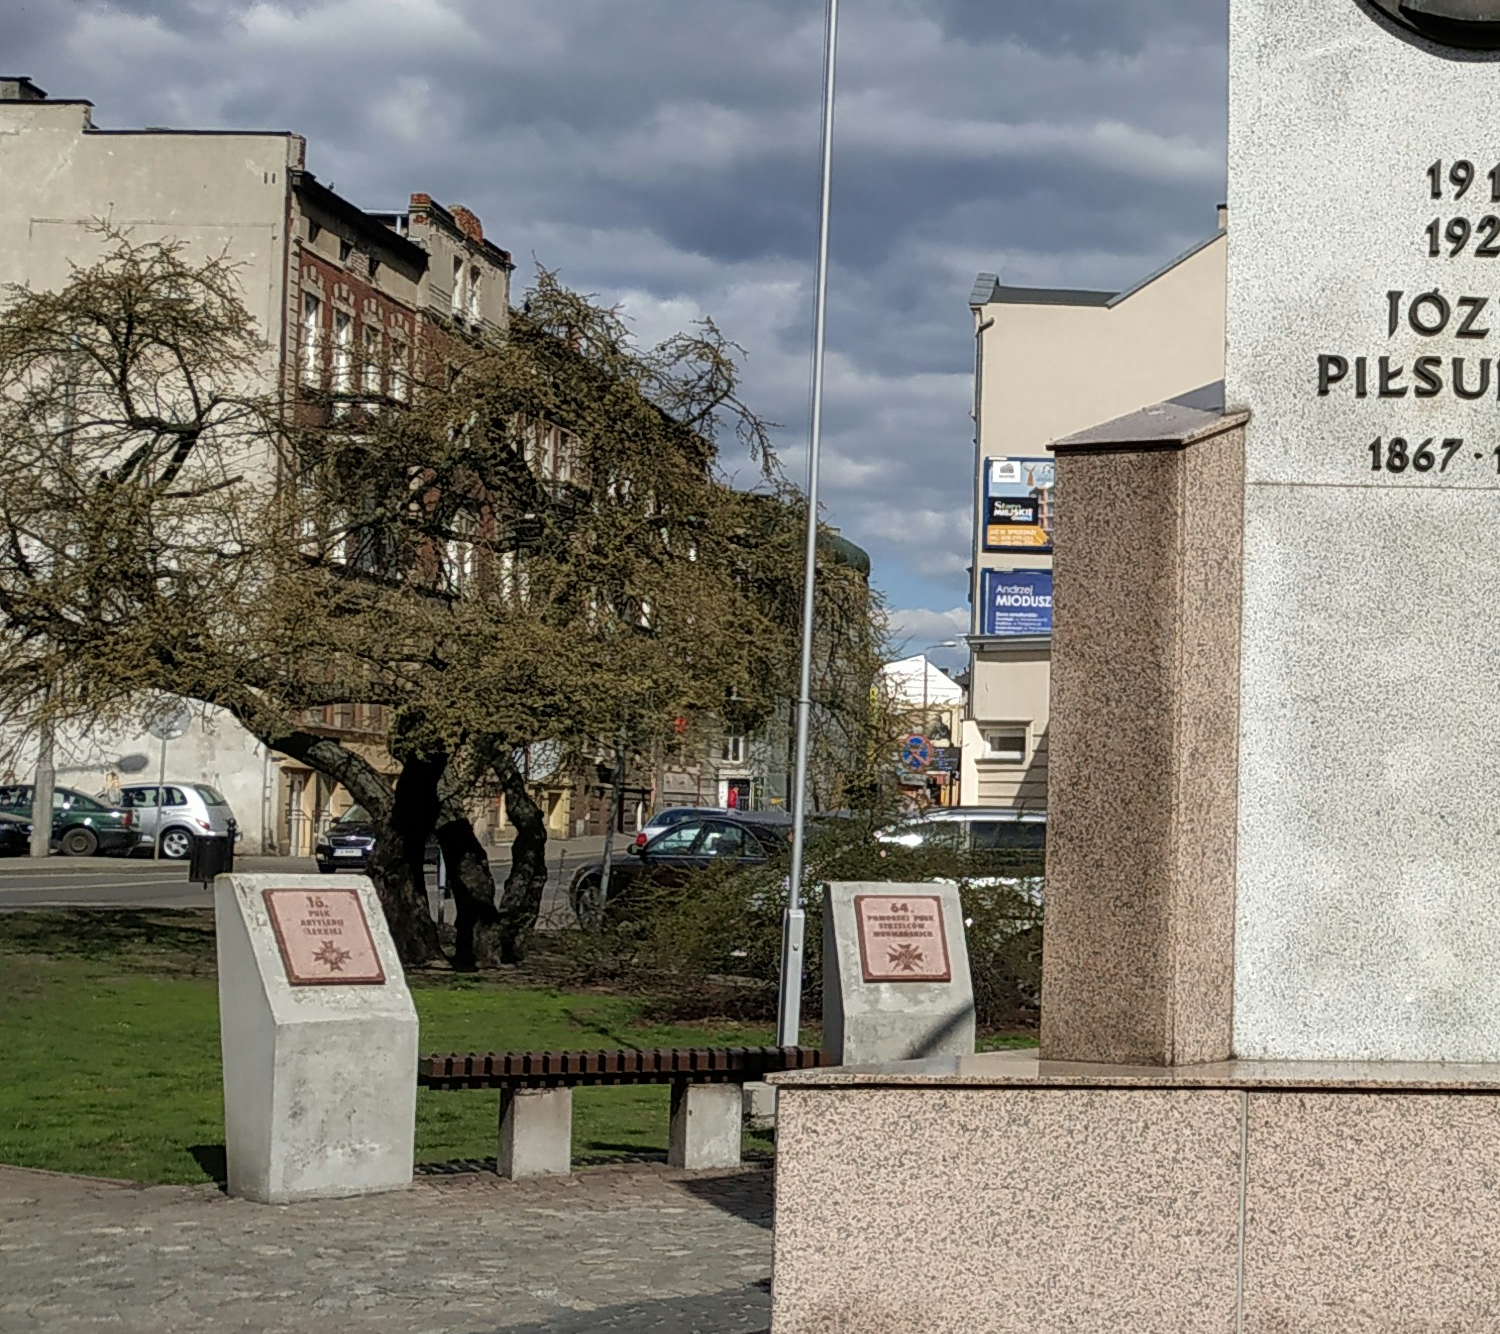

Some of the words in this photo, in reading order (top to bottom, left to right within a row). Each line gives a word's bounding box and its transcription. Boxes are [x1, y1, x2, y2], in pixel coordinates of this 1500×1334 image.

[1367, 436, 1463, 473] 1867
[995, 584, 1034, 596] Andrzej
[890, 902, 914, 913] 64.
